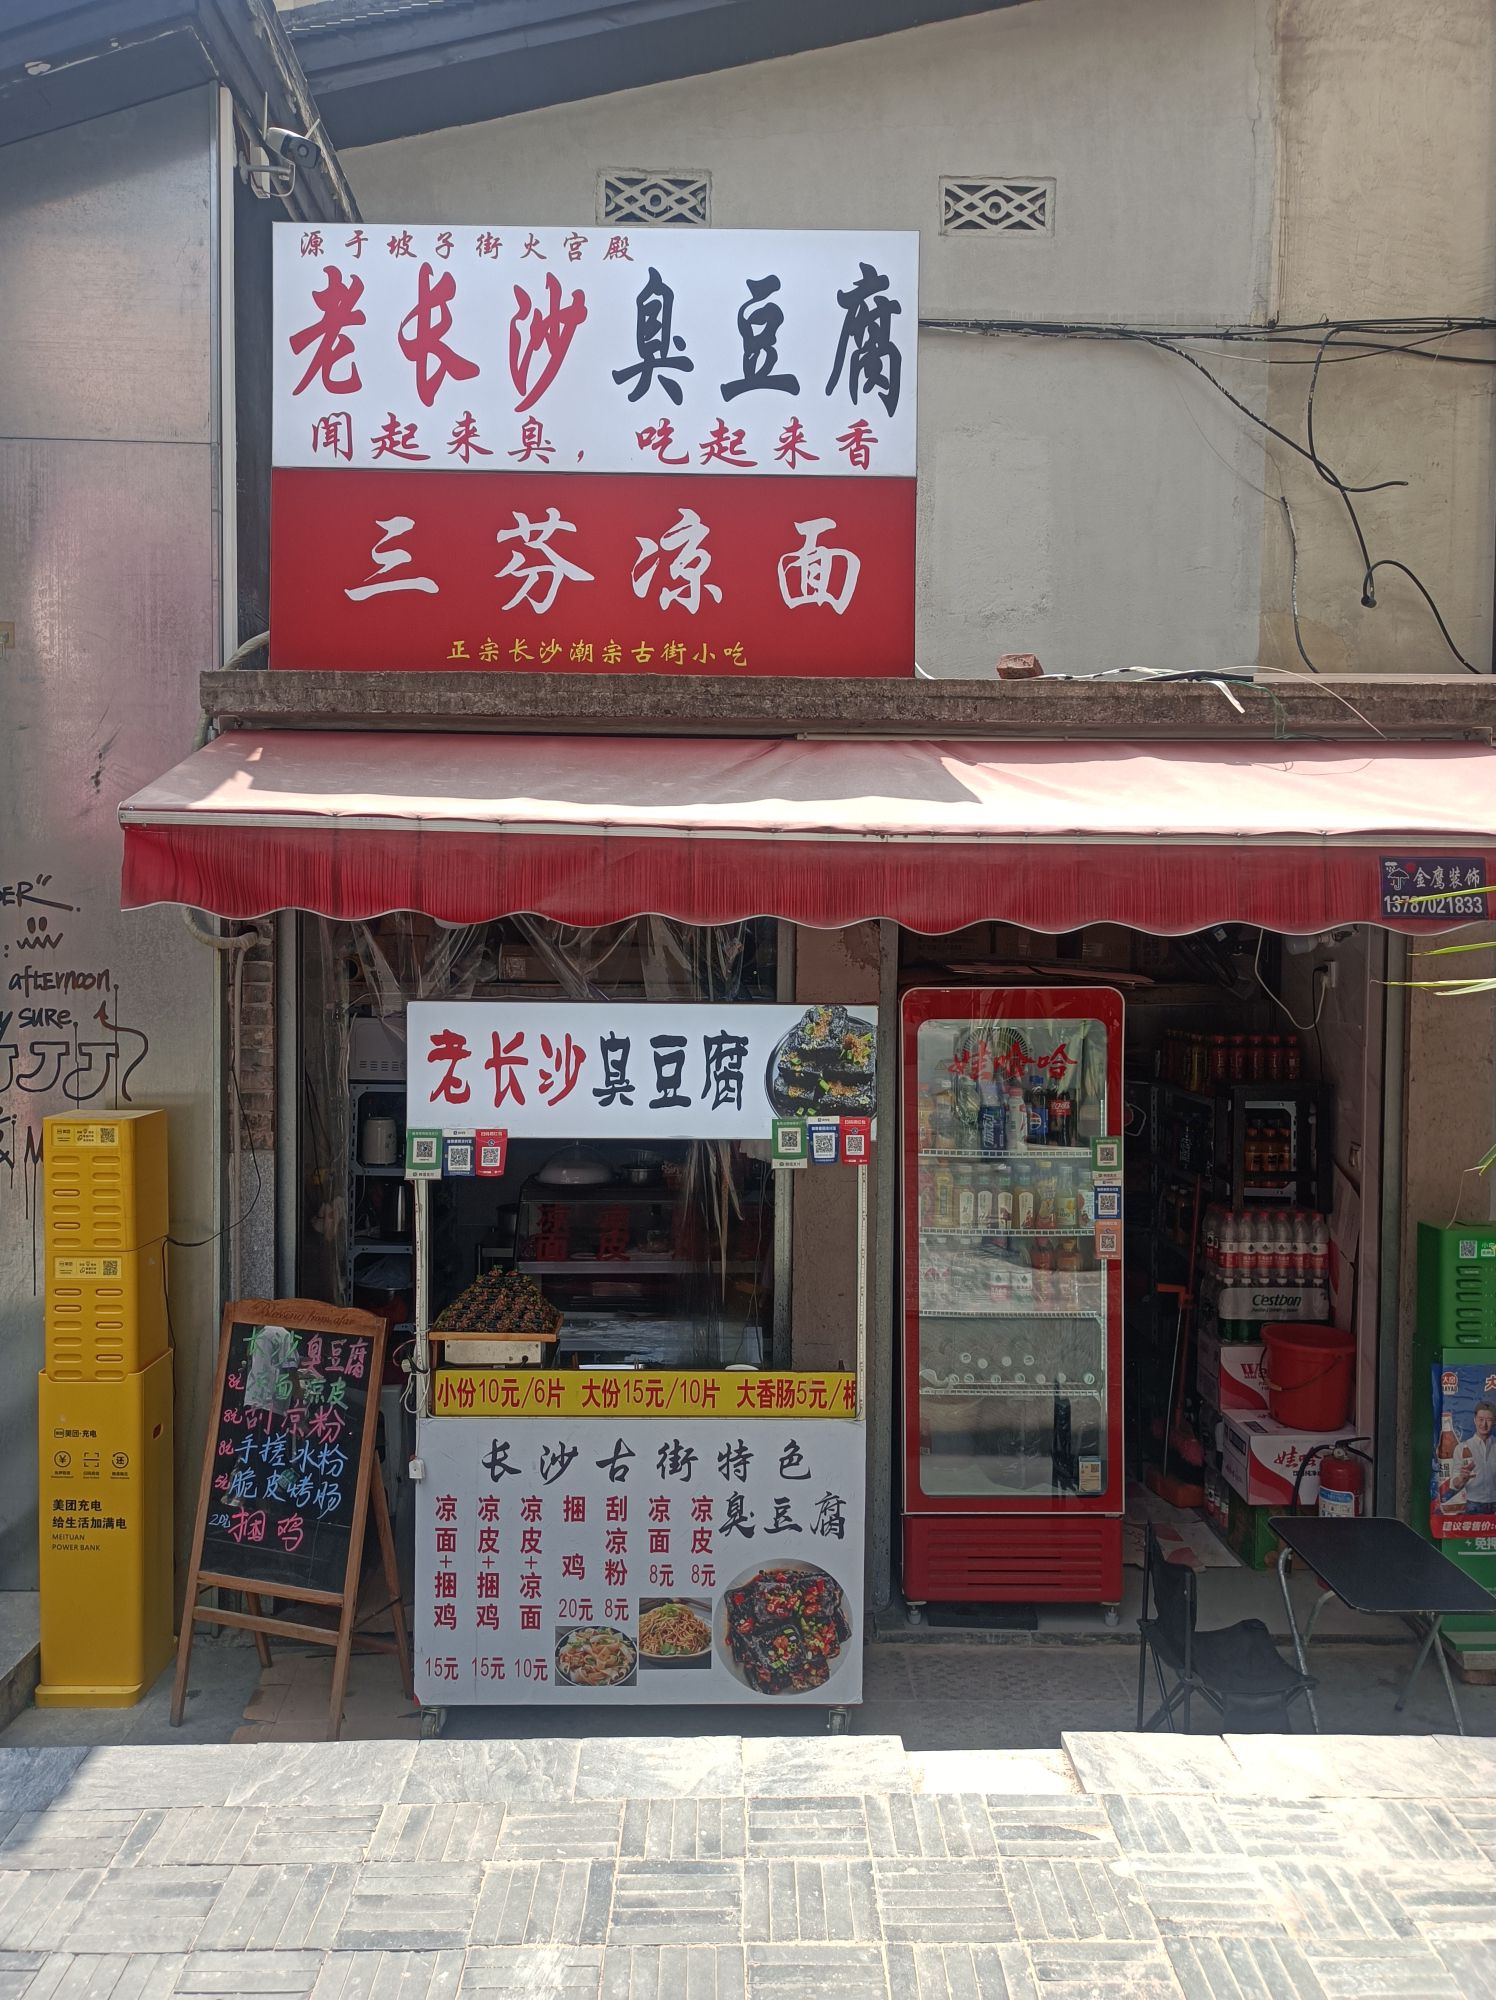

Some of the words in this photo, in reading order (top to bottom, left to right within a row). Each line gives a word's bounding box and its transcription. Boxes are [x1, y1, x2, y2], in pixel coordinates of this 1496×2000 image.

[299, 231, 636, 262] 源于坡子街火宫殿
[290, 261, 902, 418] 老长沙臭豆腐
[344, 507, 861, 616] 三芬凉面
[446, 637, 749, 668] 正宗长沙潮宗古街小吃
[1413, 866, 1480, 890] 金鹰装饰
[1384, 895, 1483, 914] 13787021833
[427, 1028, 750, 1112] 老长沙臭豆腐
[437, 1377, 566, 1410] 小份10元/6片
[581, 1377, 721, 1410] 大份15元/10片
[245, 1399, 346, 1444] 刮凉粉
[481, 1438, 812, 1486] 长沙古街特色
[52, 1499, 102, 1511] 美团充电
[230, 1466, 342, 1519] 脆皮烤肠
[52, 1516, 127, 1530] 给生活加满电
[648, 1496, 671, 1555] 凉面
[691, 1496, 714, 1555] 凉皮
[718, 1491, 847, 1541] 臭豆腐
[1442, 1521, 1496, 1532] 建议零售价:
[562, 1495, 586, 1581] 捆鸡
[604, 1495, 629, 1587] 刮凉粉
[434, 1495, 458, 1630] 凉面+捆鸡
[477, 1495, 500, 1630] 凉皮+捆鸡
[519, 1495, 543, 1631] 凉皮+凉面
[649, 1563, 674, 1587] 8元
[691, 1563, 716, 1587] 8元
[558, 1598, 594, 1621] 20元
[604, 1598, 629, 1621] 8元
[425, 1657, 459, 1681] 15元
[471, 1657, 506, 1681] 15元
[514, 1657, 548, 1681] 10元
